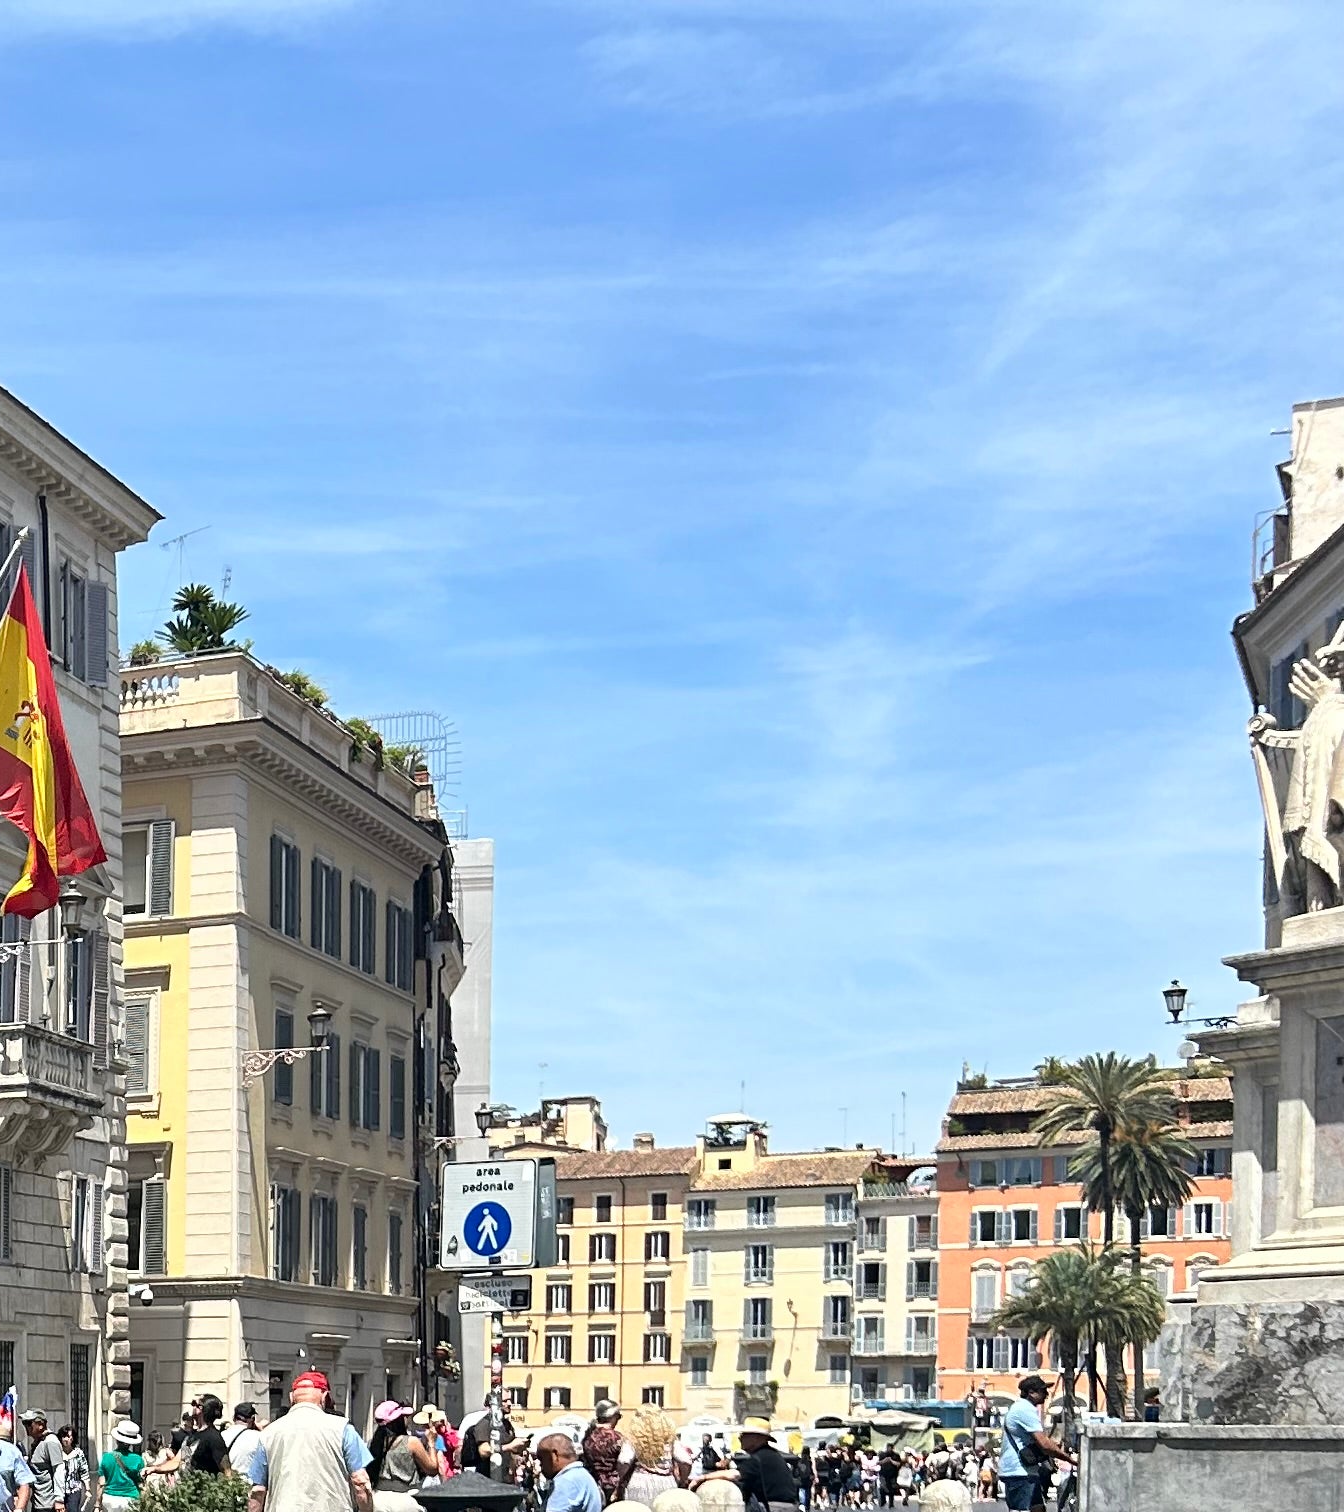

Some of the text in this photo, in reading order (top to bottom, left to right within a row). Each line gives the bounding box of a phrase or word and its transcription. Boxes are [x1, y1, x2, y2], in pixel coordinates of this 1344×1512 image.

[476, 1167, 501, 1176] area
[462, 1180, 514, 1194] pedonale
[474, 1279, 513, 1289] escluso
